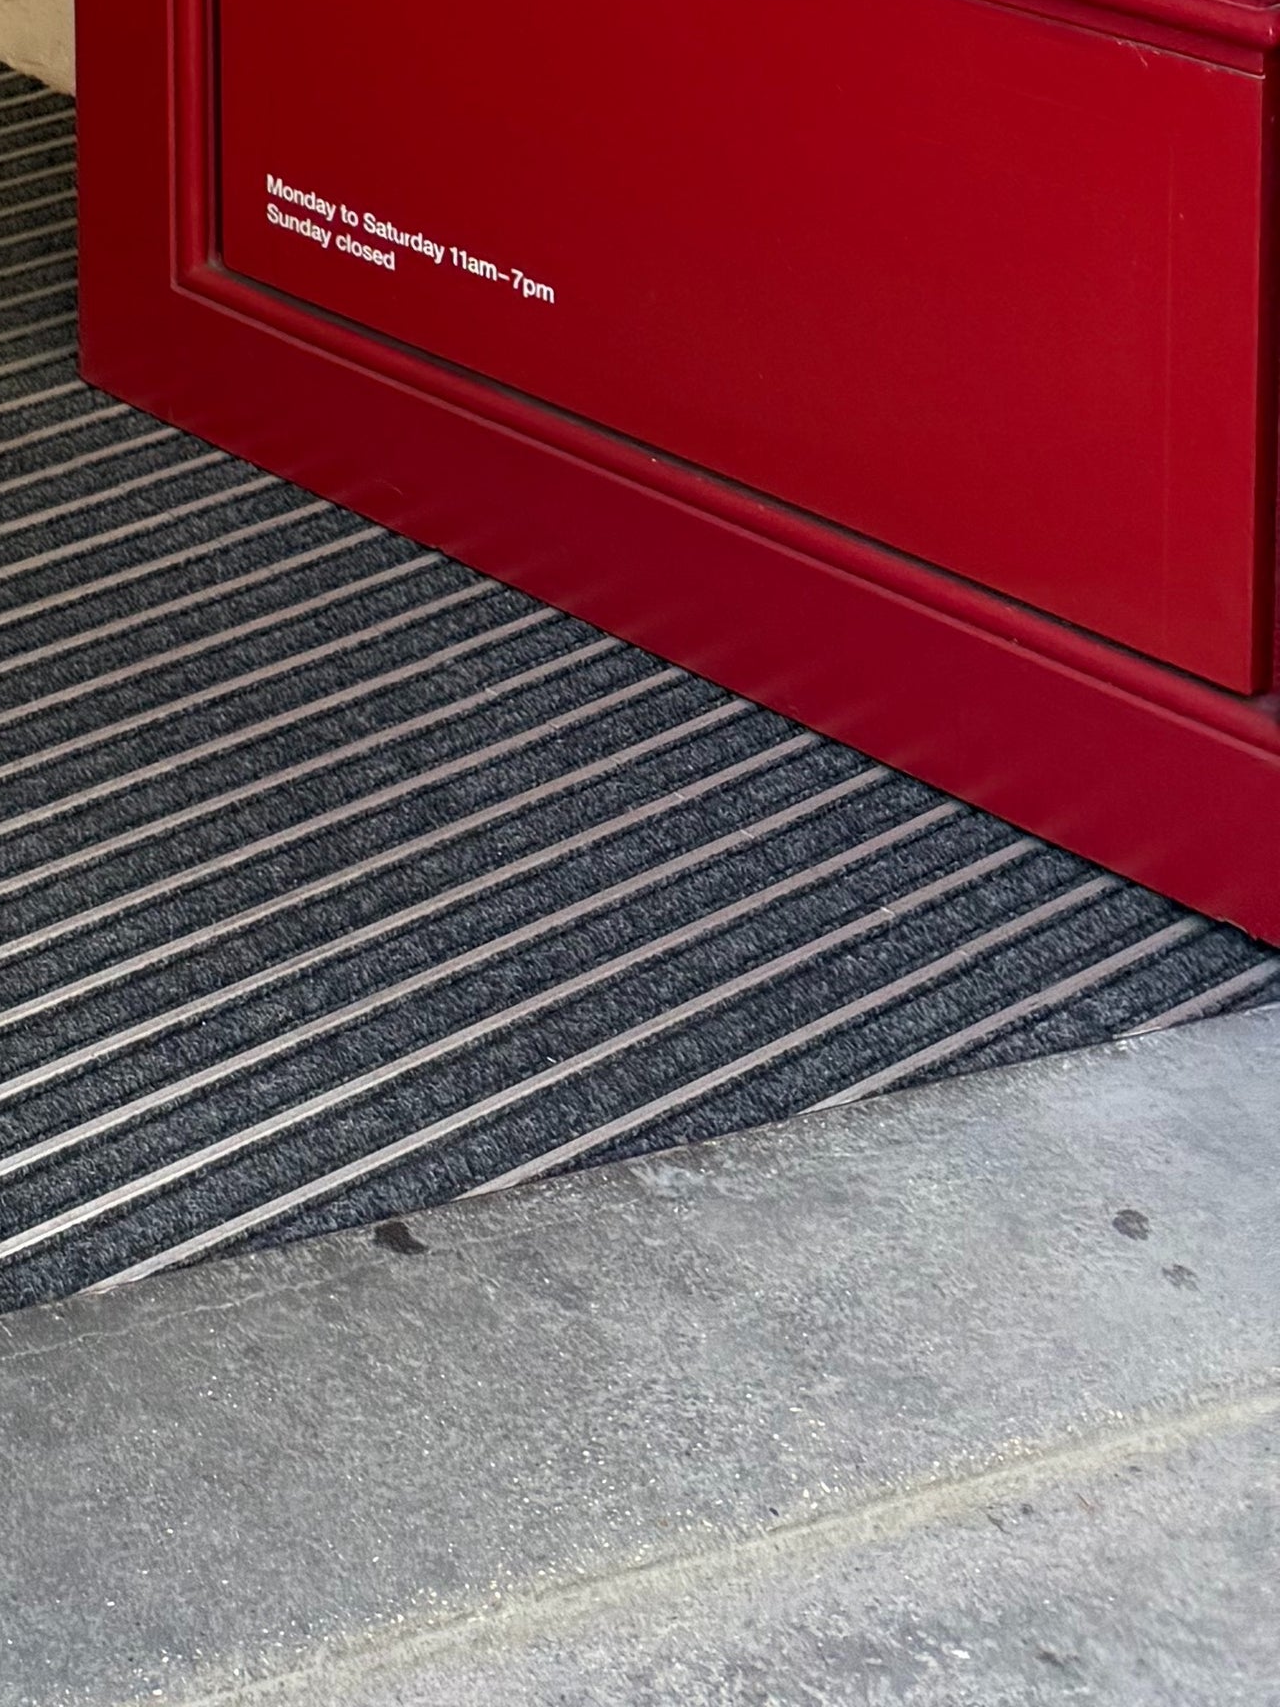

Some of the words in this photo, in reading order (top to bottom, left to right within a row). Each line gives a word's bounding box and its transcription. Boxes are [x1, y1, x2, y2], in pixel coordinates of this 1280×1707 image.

[266, 173, 336, 221] Monday
[340, 203, 359, 227] to
[363, 212, 445, 264] Saturday
[266, 202, 332, 249] Sunday
[335, 233, 396, 271] closed
